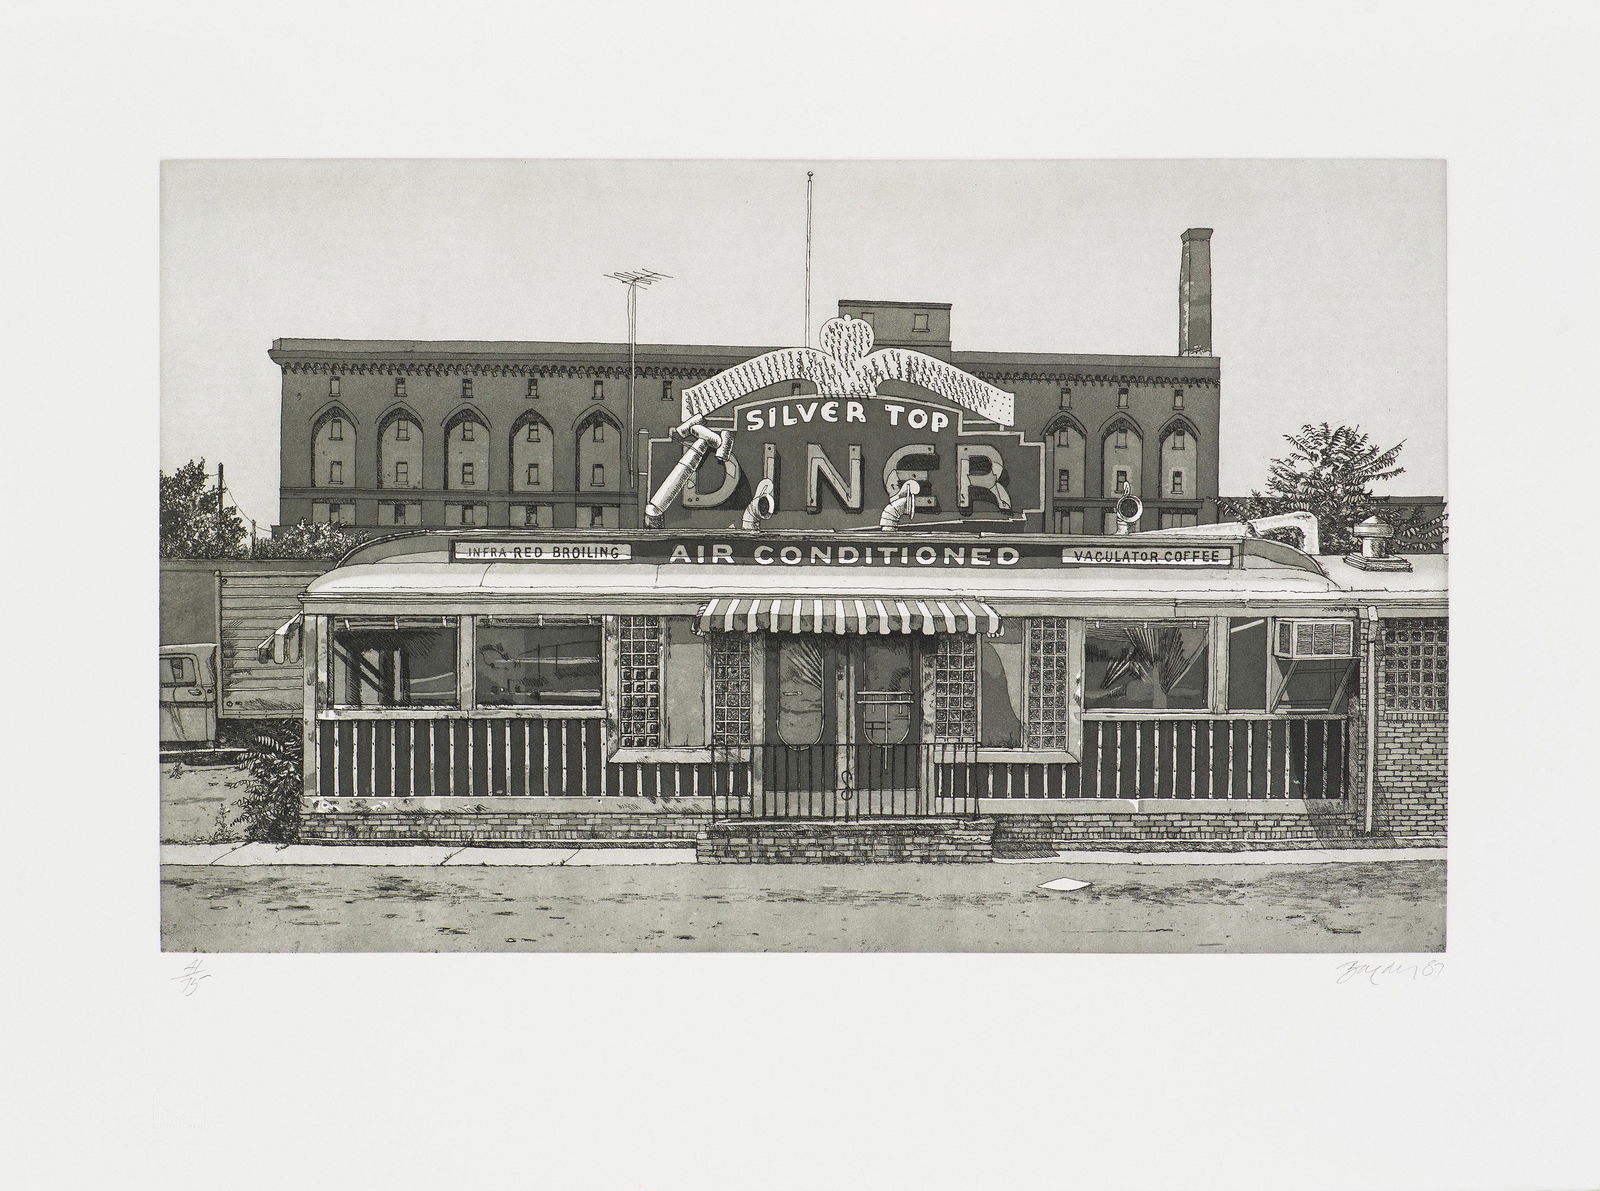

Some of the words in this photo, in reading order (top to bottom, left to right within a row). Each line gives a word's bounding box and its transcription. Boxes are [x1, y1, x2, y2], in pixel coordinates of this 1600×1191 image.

[746, 401, 867, 432] SILVER
[885, 404, 949, 434] TOP
[682, 443, 1013, 512] DINER
[552, 541, 620, 558] BROILING
[669, 544, 735, 564] AIR
[753, 545, 1020, 566] CONDITIONED
[1074, 550, 1158, 563] VACULATOR
[1164, 550, 1220, 563] COFFEE
